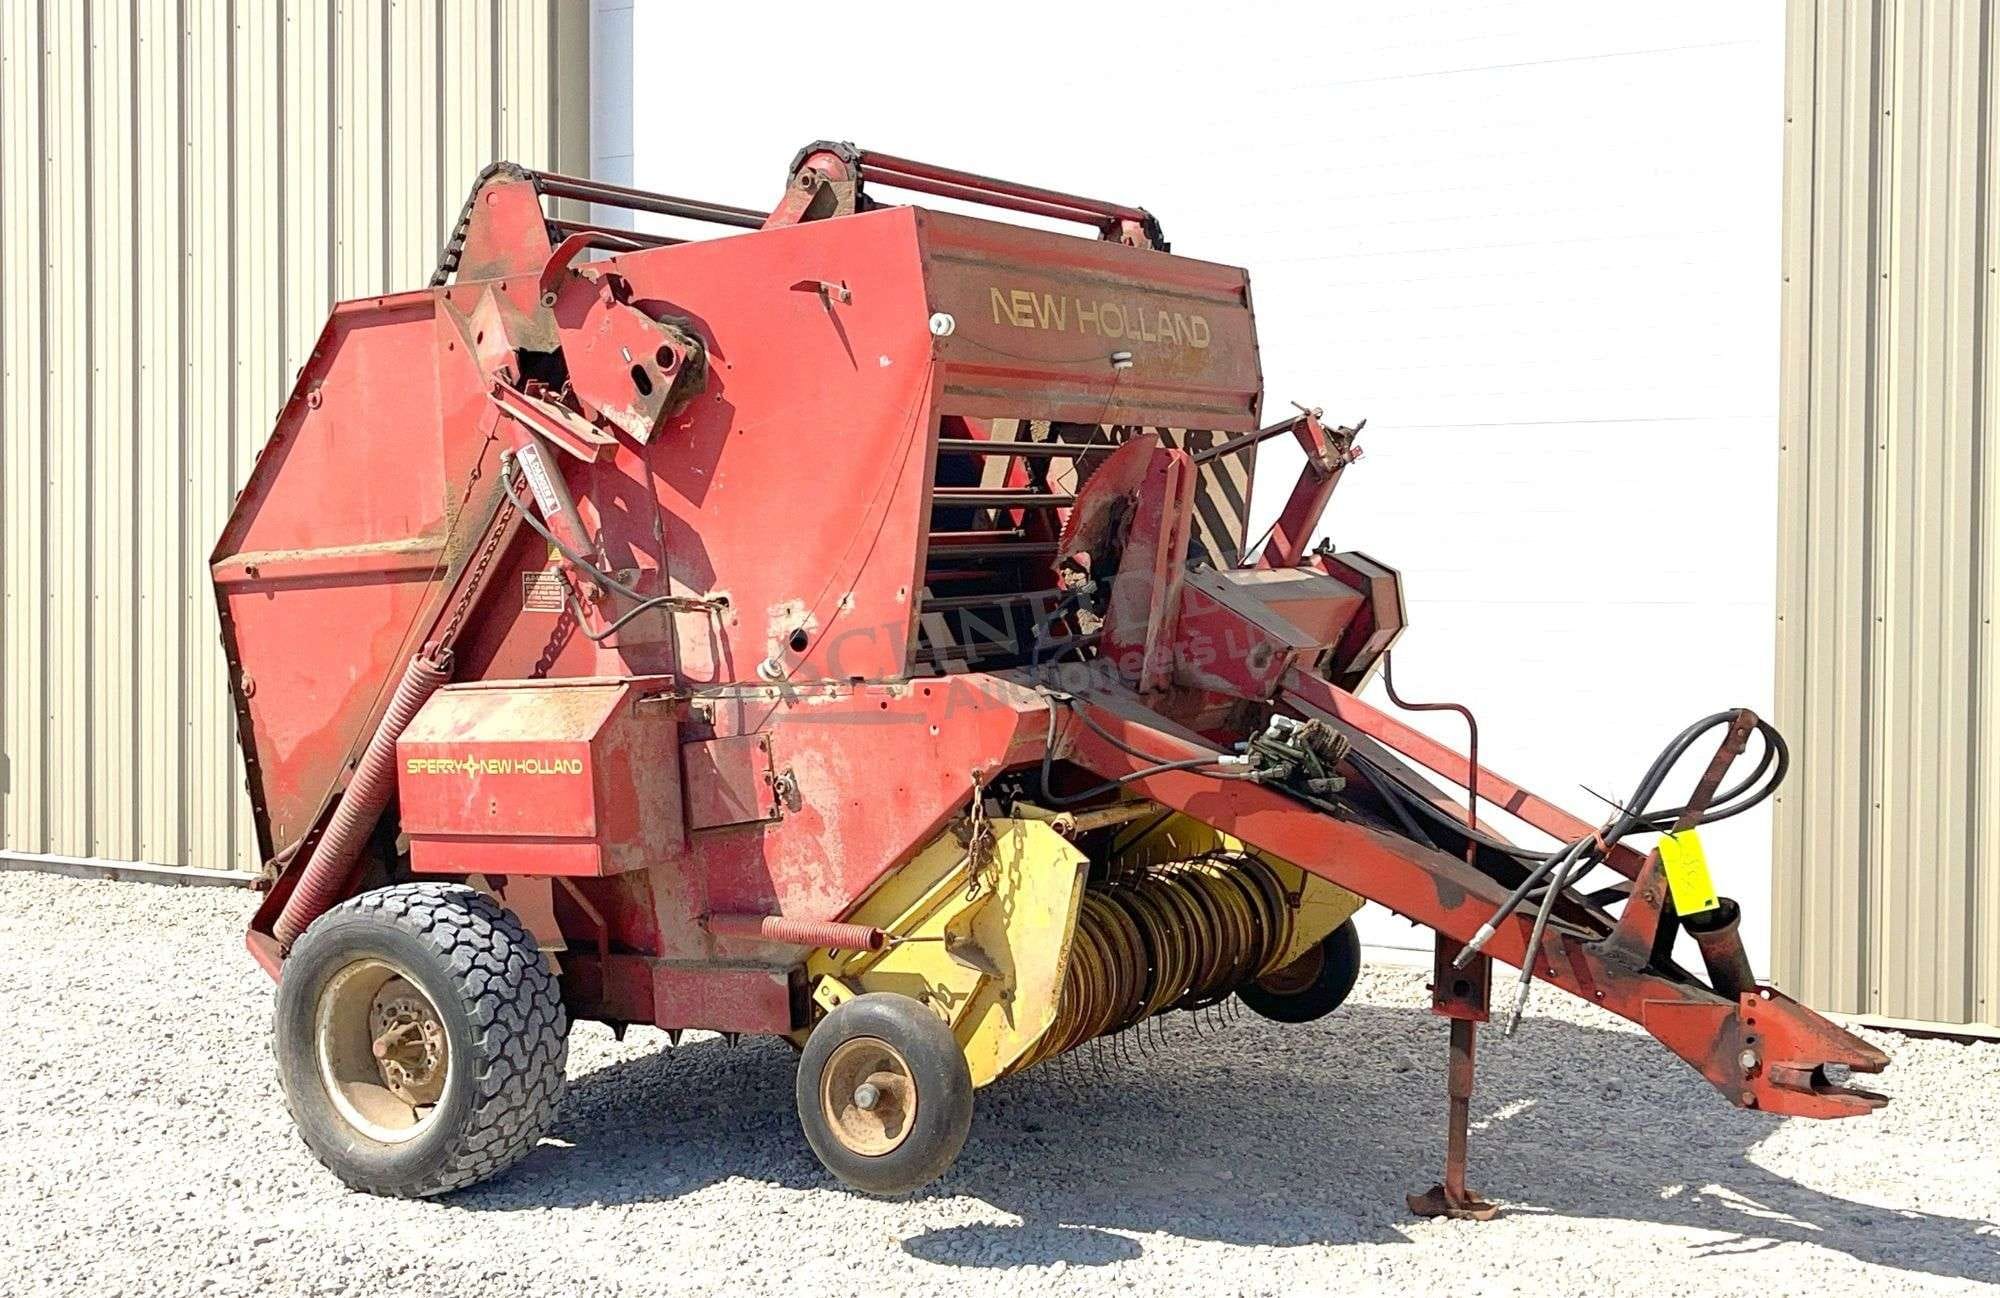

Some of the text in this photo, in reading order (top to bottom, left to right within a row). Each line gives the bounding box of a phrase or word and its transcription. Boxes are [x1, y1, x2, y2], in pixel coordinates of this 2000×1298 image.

[990, 287, 1210, 348] NEW HOLLAND
[407, 758, 583, 775] SPERRY NEW HOLLAND
